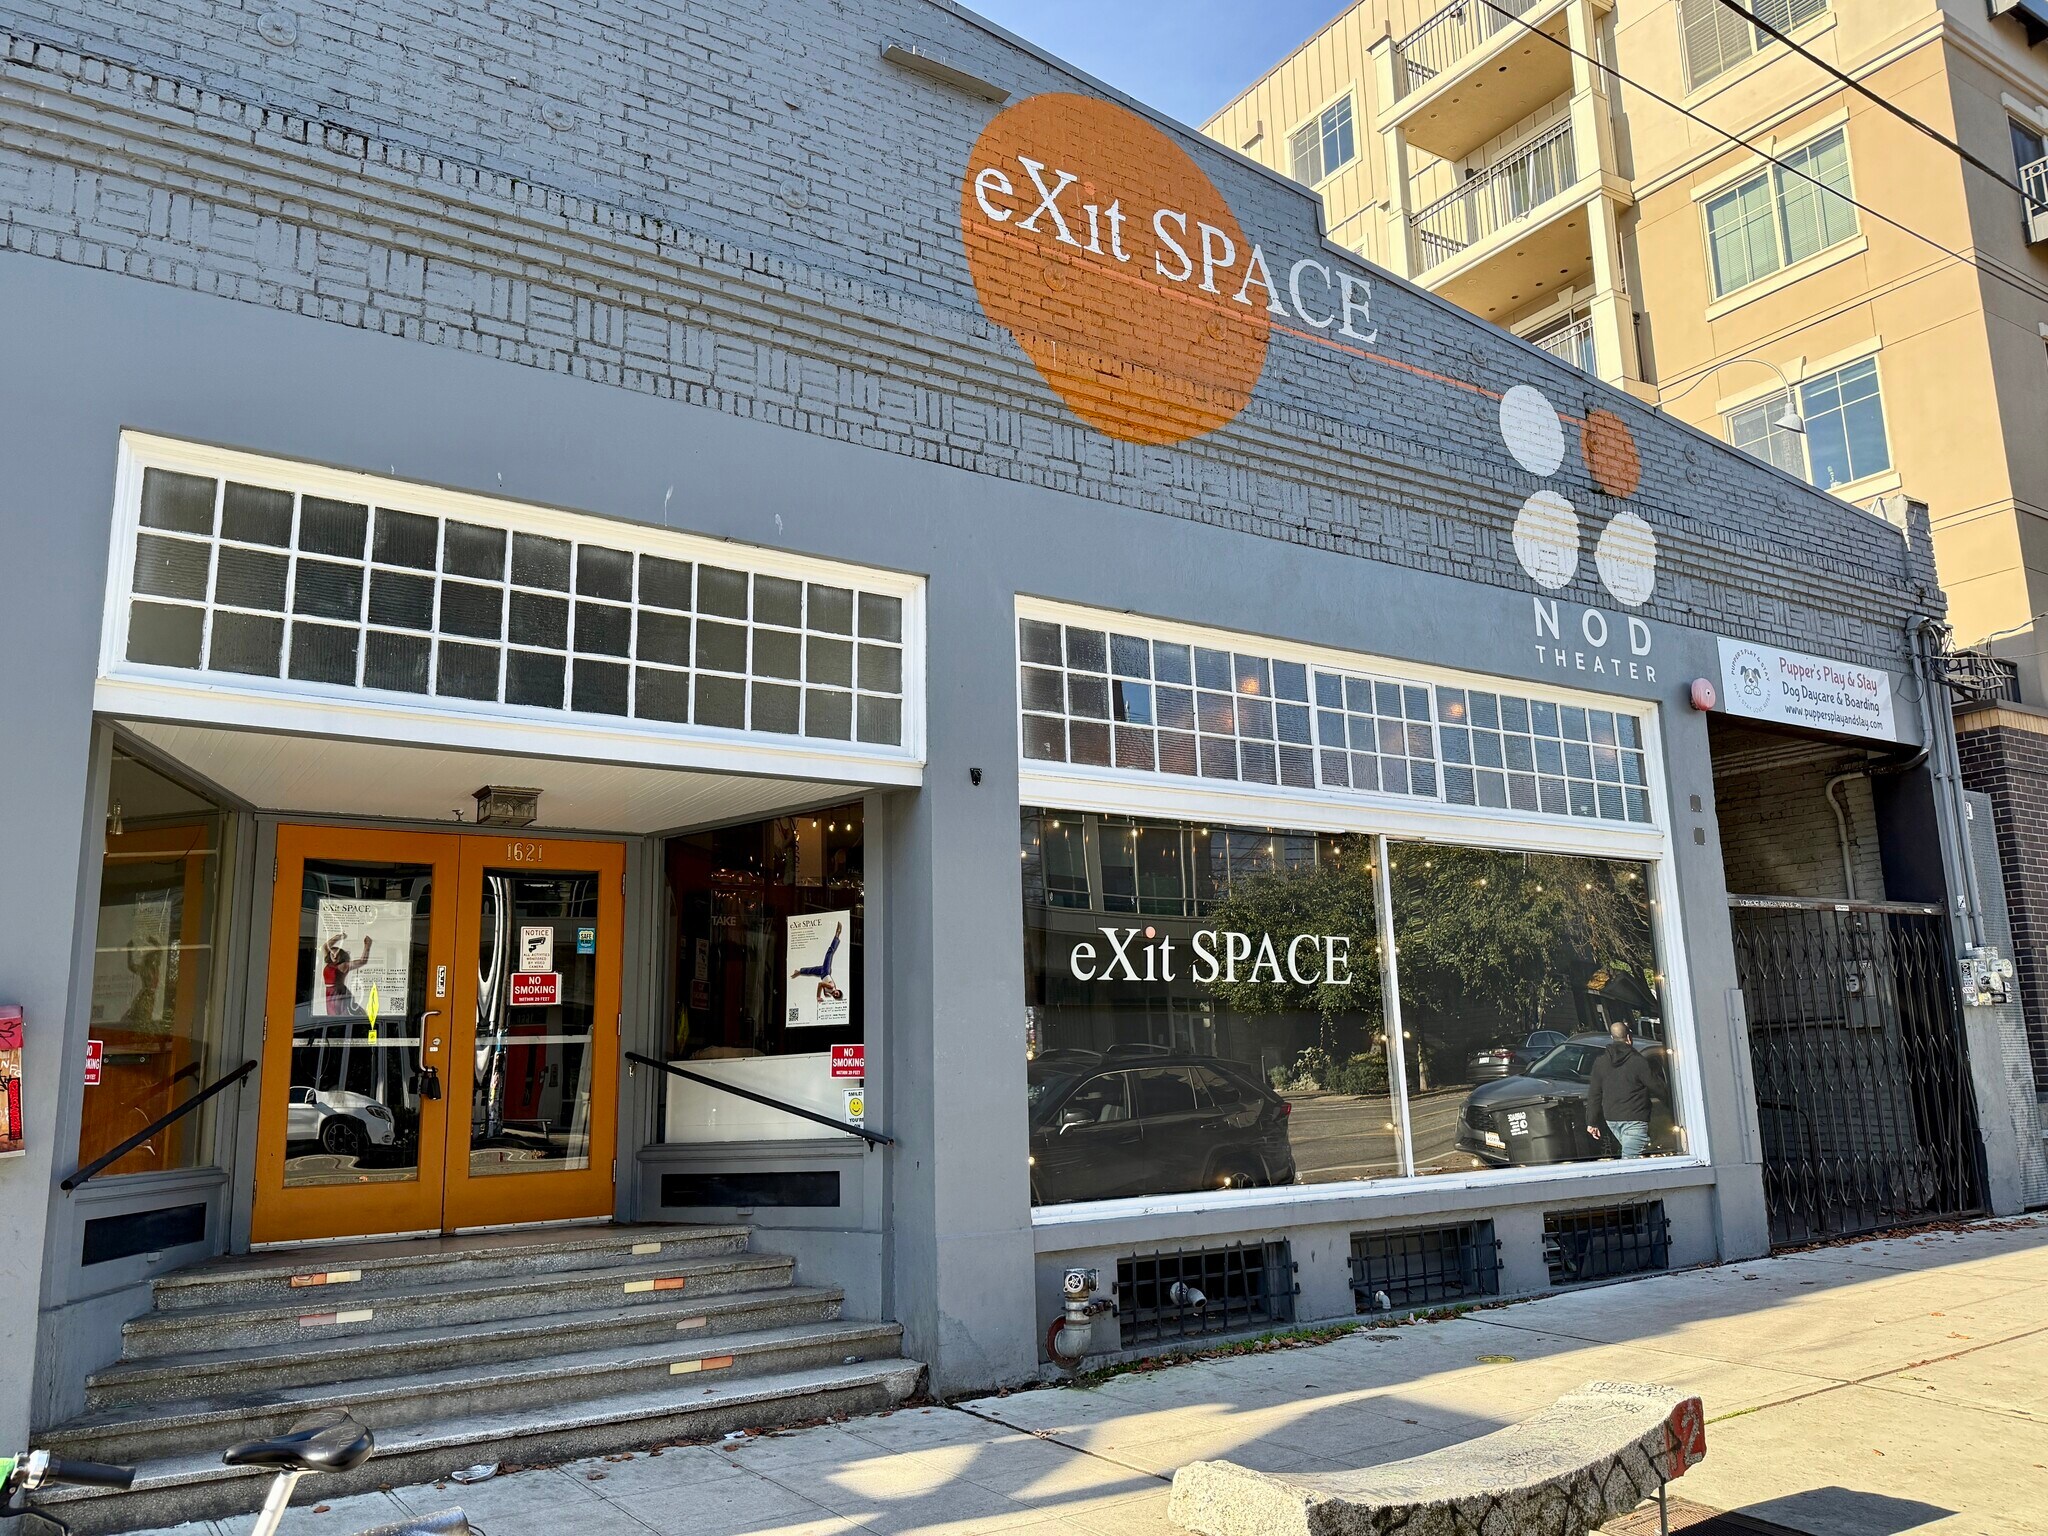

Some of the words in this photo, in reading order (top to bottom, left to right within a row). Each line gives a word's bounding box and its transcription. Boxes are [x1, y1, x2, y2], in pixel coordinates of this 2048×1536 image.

[975, 155, 1130, 262] eXit
[1152, 208, 1378, 344] SPACE
[1533, 596, 1652, 656] NOD
[1535, 644, 1657, 682] THEATER
[1779, 657, 1821, 682] Pupper's
[1823, 665, 1845, 690] Play
[1847, 671, 1855, 687] &
[1856, 673, 1878, 697] Stay
[1781, 681, 1800, 702] Dog
[1801, 685, 1835, 706] Daycare
[1837, 692, 1843, 705] &
[1844, 693, 1880, 717] Boarding
[1785, 705, 1883, 731] www.puppersplayandstay.com
[506, 842, 542, 861] 1621
[341, 904, 371, 913] SPACE
[711, 915, 737, 926] TAKE
[1070, 926, 1176, 982] eXit
[1191, 930, 1353, 985] SPACE
[514, 985, 555, 995] SMOKING
[528, 976, 541, 985] NO
[832, 1057, 865, 1067] SMOKING
[843, 1047, 854, 1057] NO
